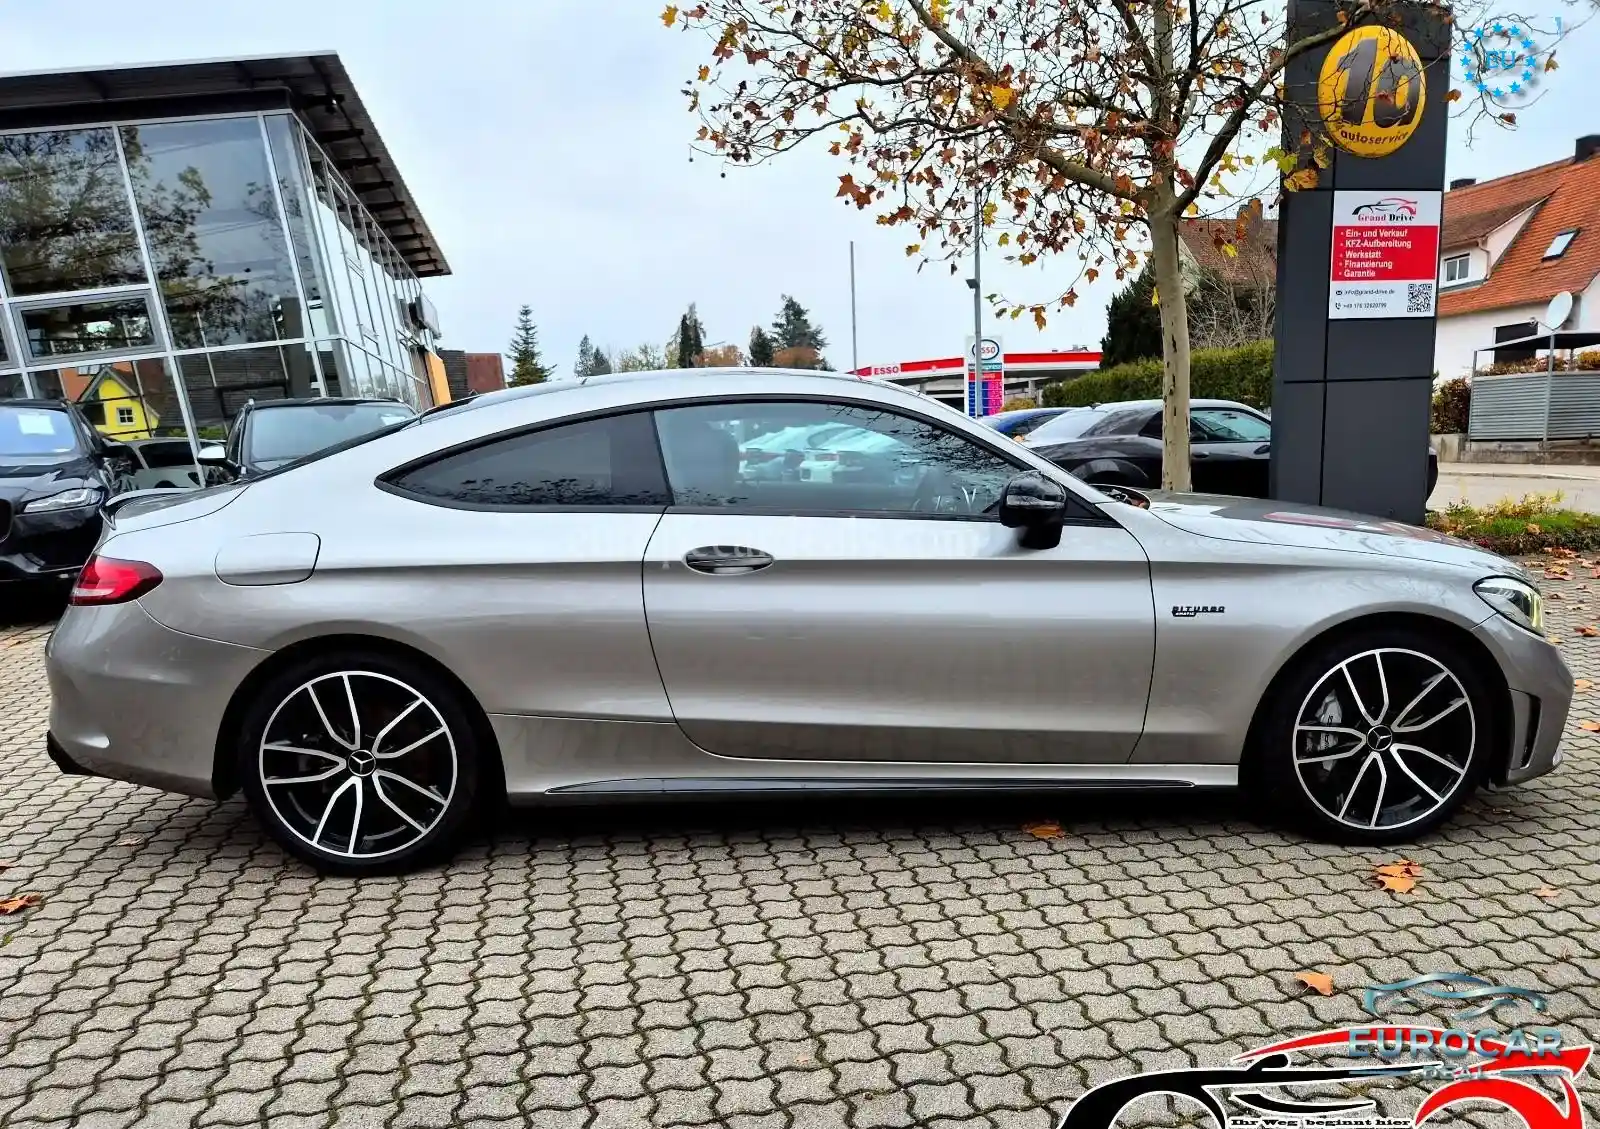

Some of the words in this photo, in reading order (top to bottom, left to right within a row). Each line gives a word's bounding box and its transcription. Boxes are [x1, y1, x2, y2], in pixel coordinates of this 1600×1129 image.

[1358, 213, 1387, 222] Grand
[1389, 213, 1415, 222] Drive
[1345, 229, 1361, 238] Ein-
[1363, 229, 1378, 238] und
[1379, 229, 1408, 238] Verkauf
[1345, 240, 1412, 249] KFZ-Aufbereitung
[1345, 251, 1382, 259] Werkstatt
[1344, 260, 1393, 270] Finanzierung
[1344, 270, 1376, 278] Garantie
[977, 346, 996, 354] SSO
[874, 366, 899, 375] ESSO
